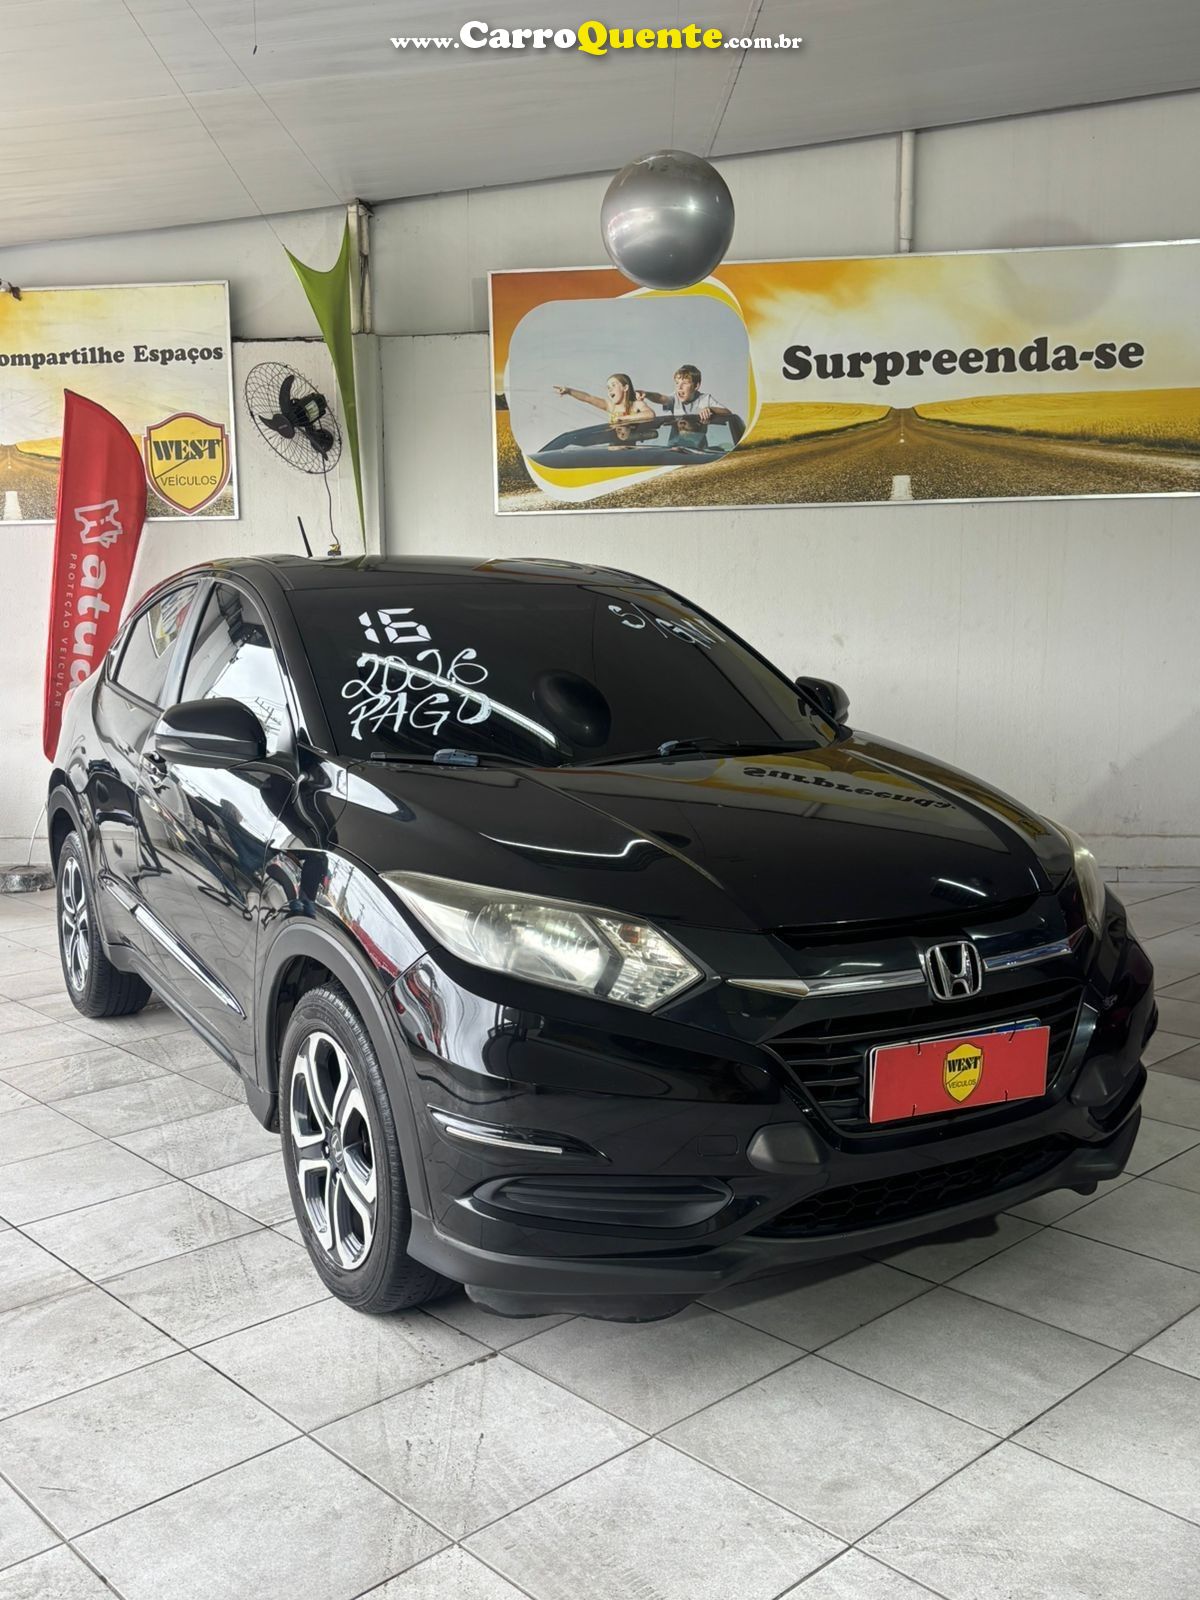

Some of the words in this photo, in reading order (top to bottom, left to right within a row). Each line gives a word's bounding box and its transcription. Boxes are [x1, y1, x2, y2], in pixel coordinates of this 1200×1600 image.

[0, 346, 125, 370] ompartilhe
[133, 344, 224, 365] Espaços
[781, 336, 1145, 386] Surpreenda-se
[153, 438, 222, 461] WEST
[62, 552, 78, 629] PROTEÇÃO
[358, 607, 432, 644] 16
[54, 637, 68, 708] VEICULAR
[341, 648, 488, 699] 2026
[348, 691, 492, 740] PAGO
[947, 1055, 981, 1073] WEST
